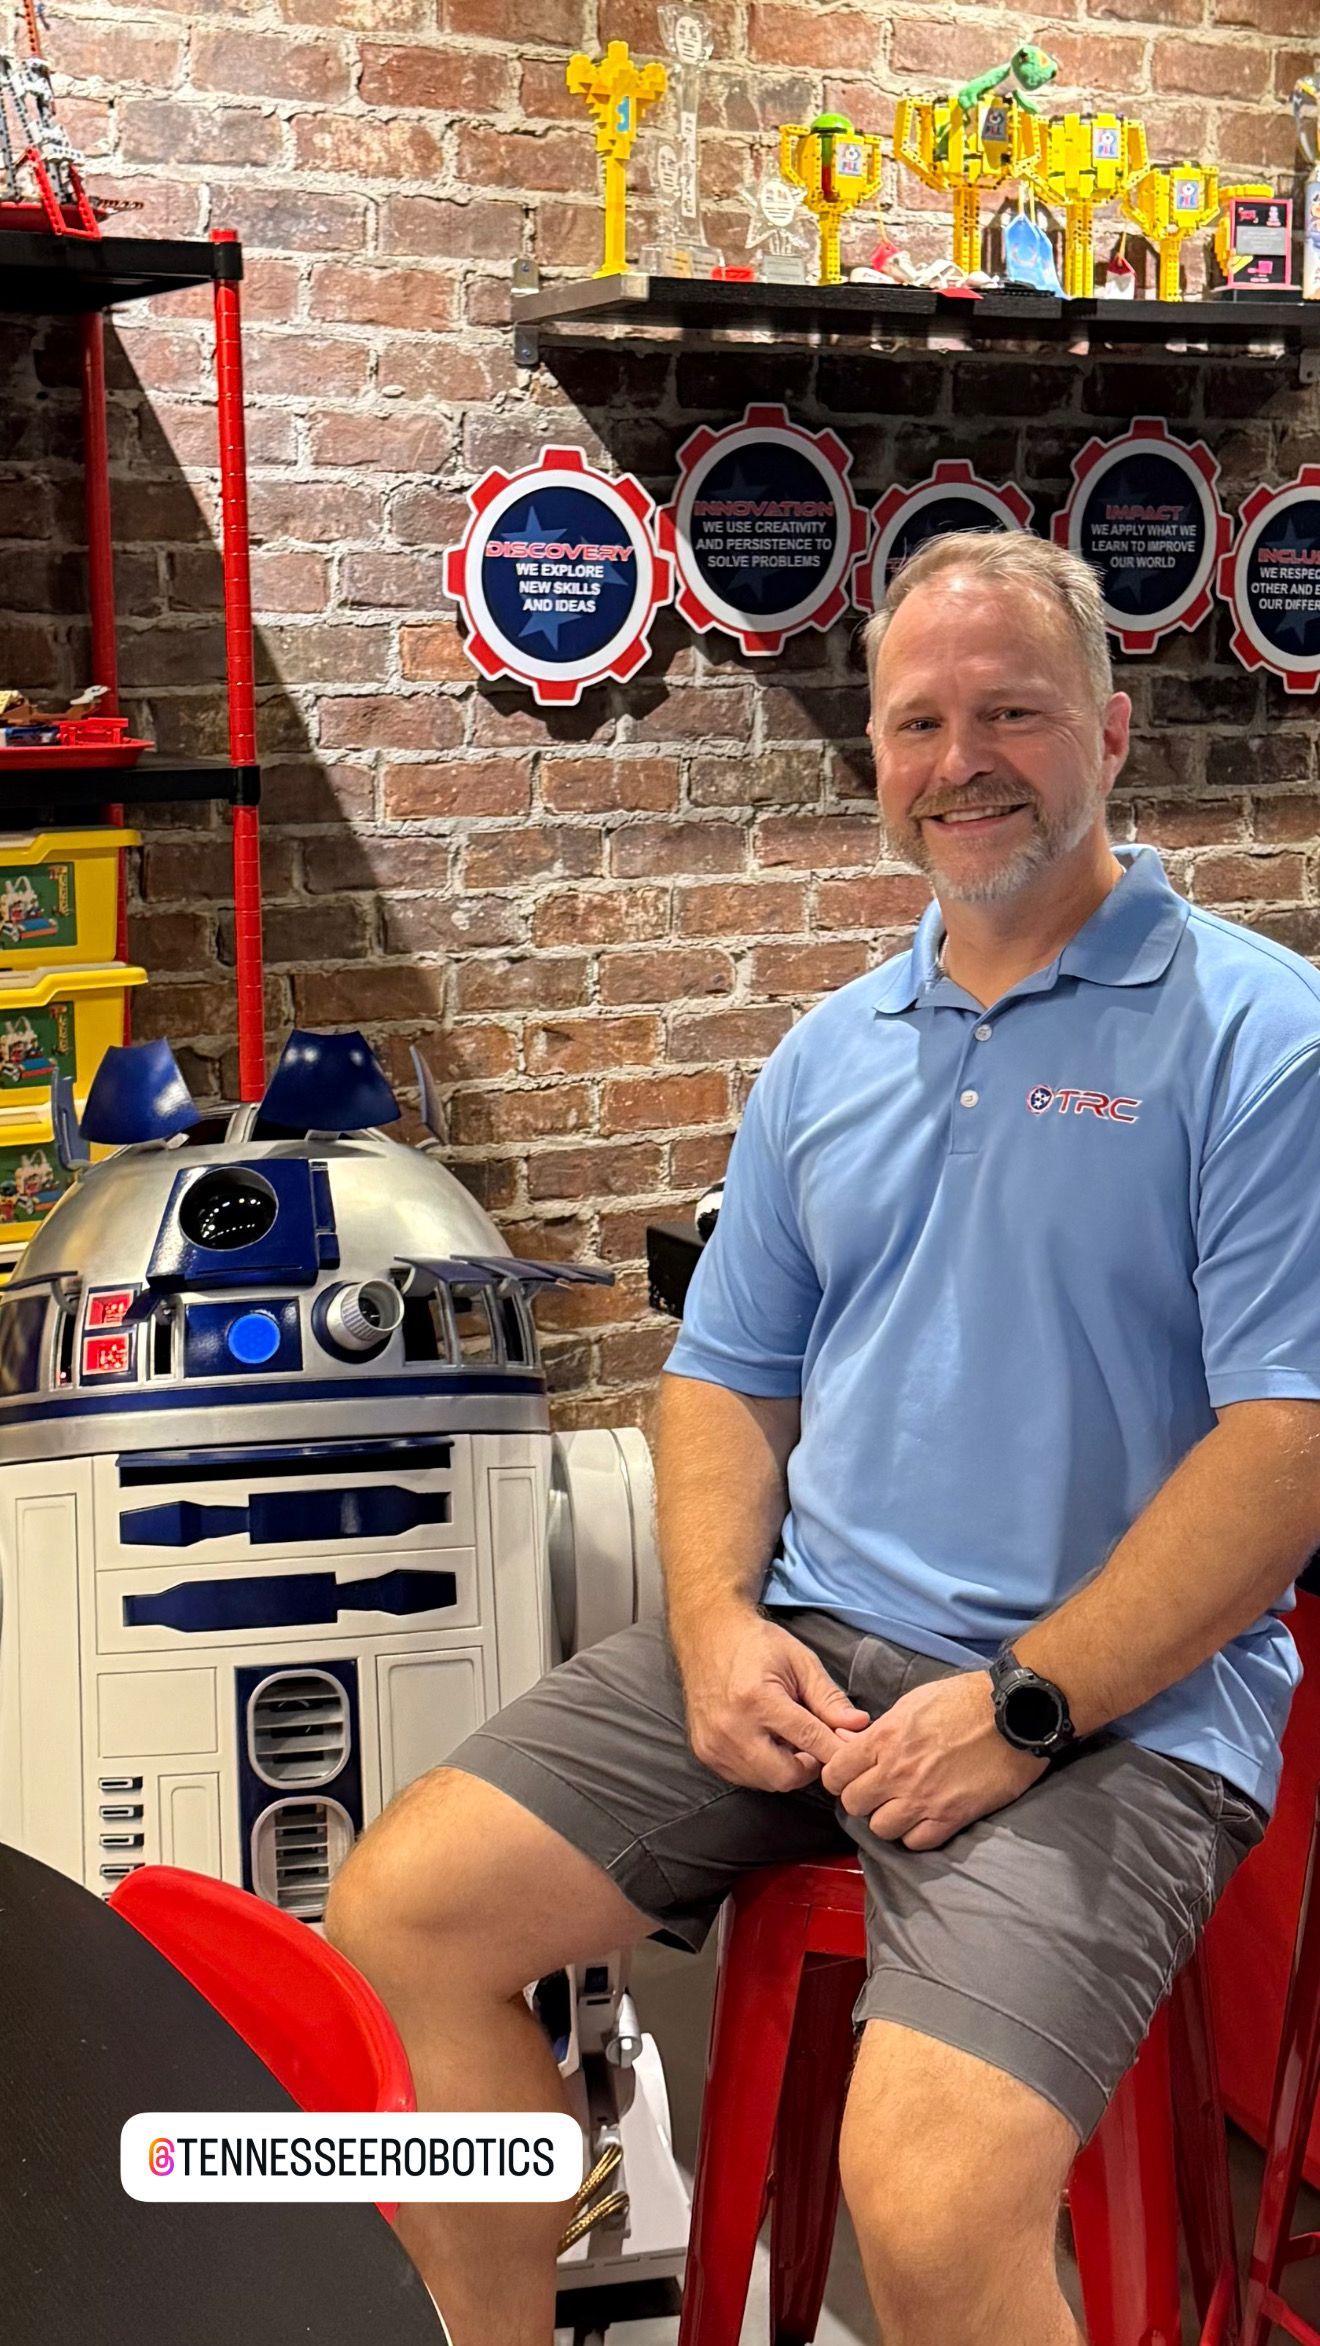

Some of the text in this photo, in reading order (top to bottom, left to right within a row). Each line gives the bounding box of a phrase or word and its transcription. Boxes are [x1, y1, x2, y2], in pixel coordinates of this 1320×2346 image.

[694, 500, 834, 517] INNOVATION
[1105, 504, 1184, 521] IMPACT
[702, 521, 827, 533] WE USE CREATIVITY
[1090, 523, 1197, 536] WE APPLY WHAT WE
[695, 538, 832, 550] AND PERSISTENCE TO
[1091, 540, 1196, 553] LEARN TO IMPROVE
[485, 540, 635, 562] DISCOVERY
[707, 555, 821, 568] SOLVE PROBLEMS
[1109, 556, 1176, 569] OUR WORLD
[516, 563, 604, 578] WE EXPLORE
[1259, 566, 1279, 579] WE
[519, 580, 601, 596] NEW SKILLS
[1250, 582, 1289, 595] OTHER
[1289, 583, 1313, 596] AND
[522, 598, 596, 613] AND IDEAS
[1258, 598, 1283, 610] OUR
[1055, 1088, 1144, 1124] TRC
